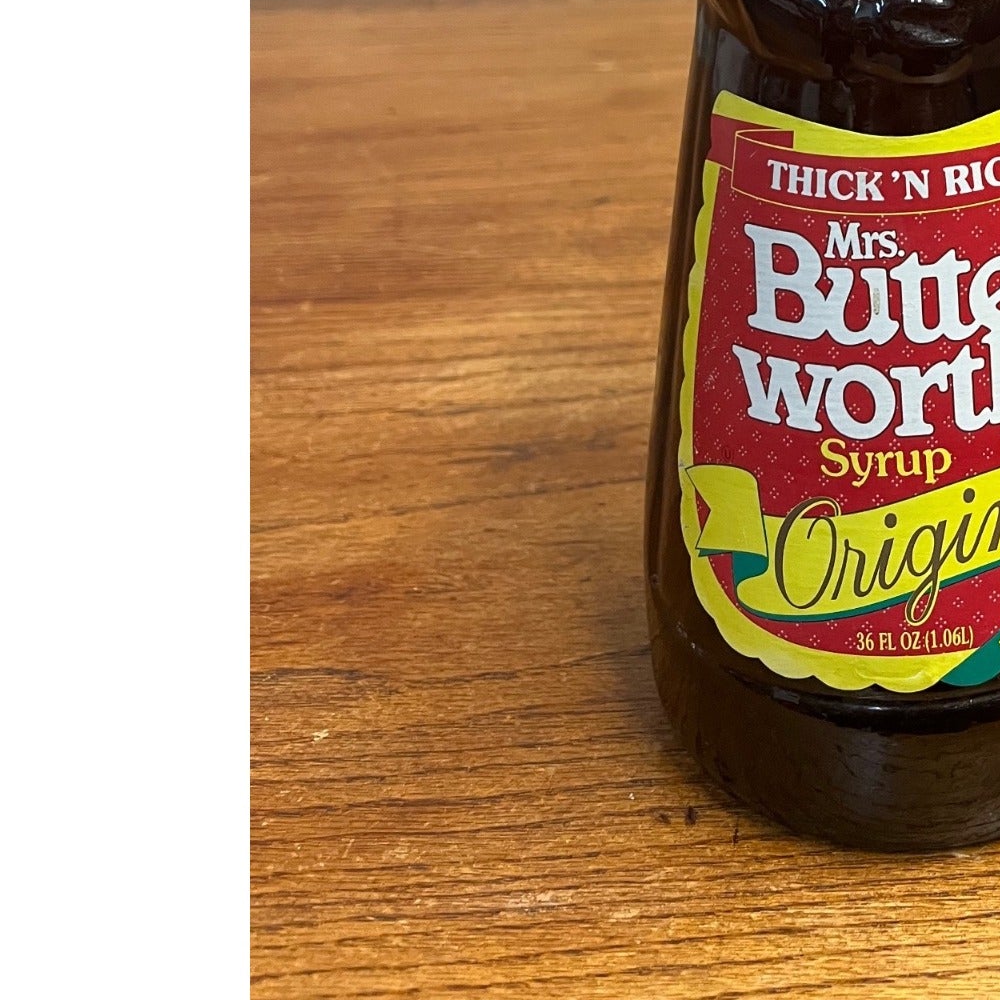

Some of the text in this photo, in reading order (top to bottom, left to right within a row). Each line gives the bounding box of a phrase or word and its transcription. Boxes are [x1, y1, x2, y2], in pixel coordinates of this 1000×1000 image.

[767, 159, 884, 202] THICK
[892, 169, 930, 200] 'N
[824, 221, 906, 261] Mrs.
[819, 438, 953, 488] Syrup
[856, 625, 975, 653] 36 FL OZ (1.06L)
